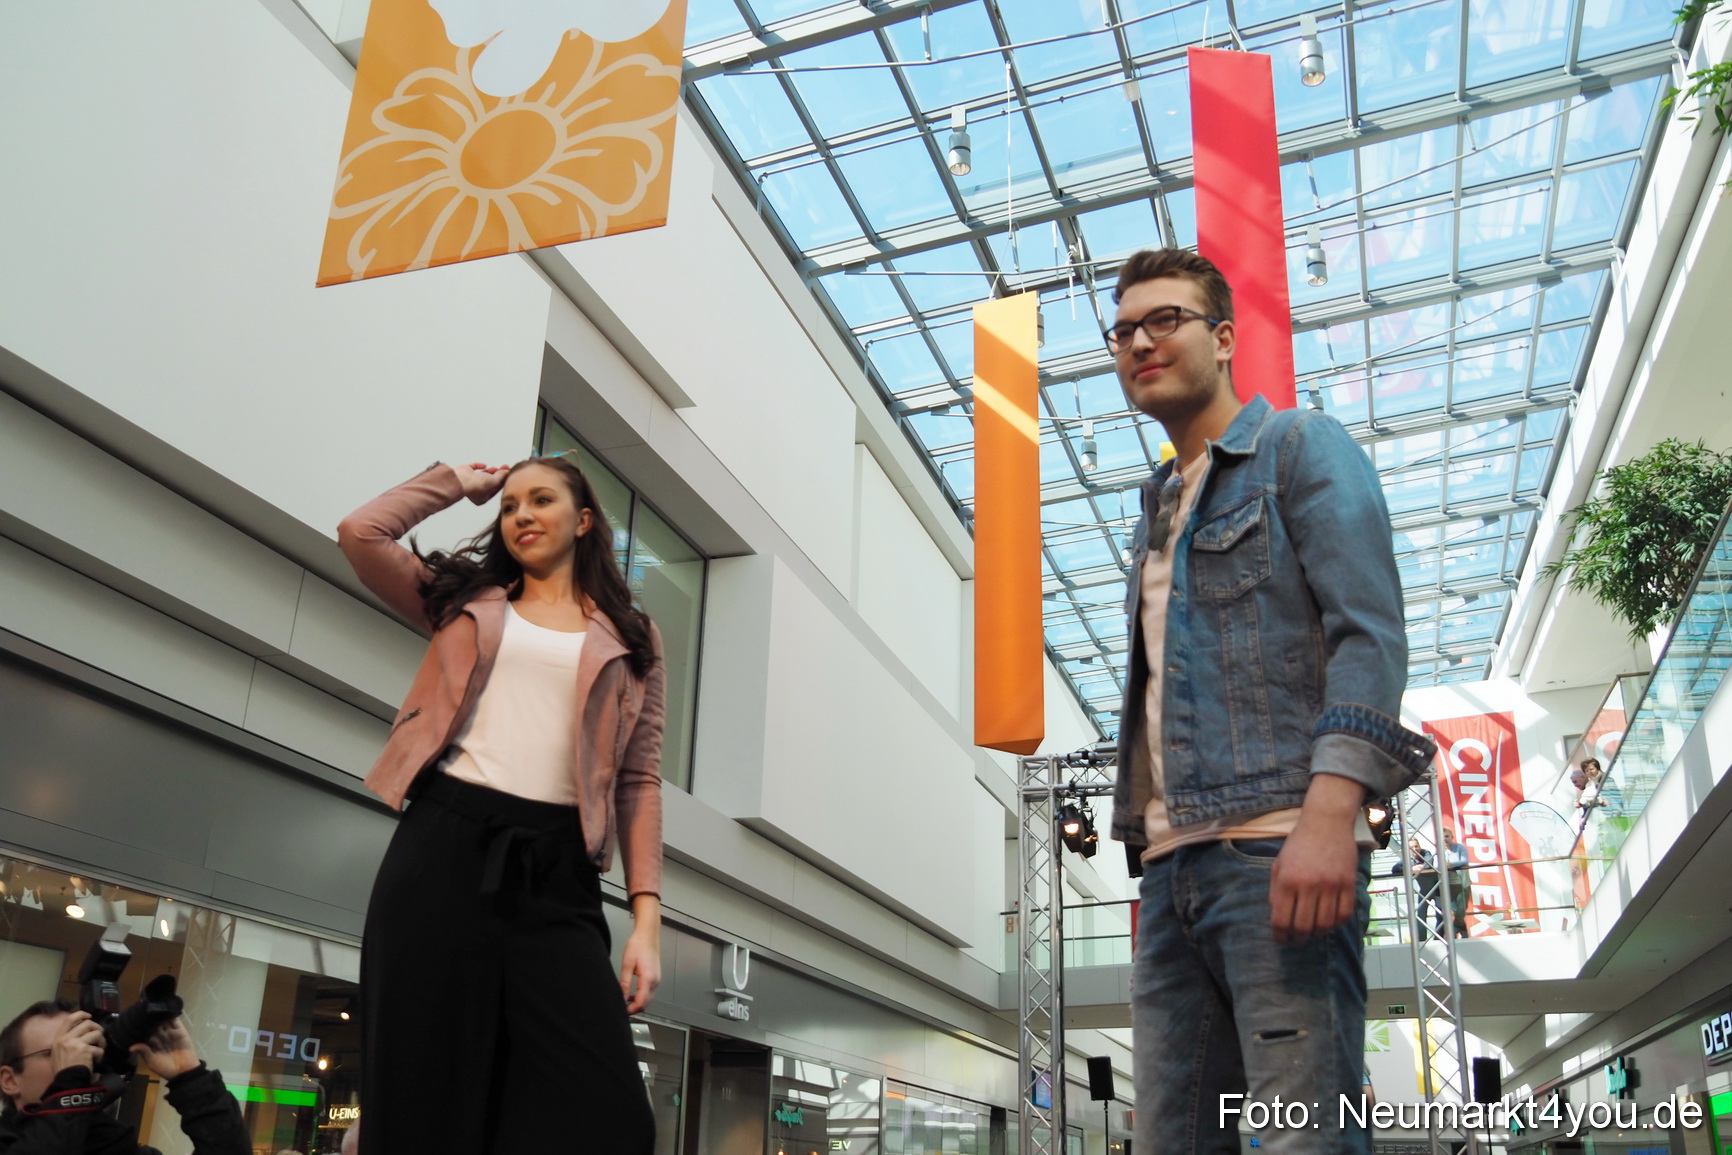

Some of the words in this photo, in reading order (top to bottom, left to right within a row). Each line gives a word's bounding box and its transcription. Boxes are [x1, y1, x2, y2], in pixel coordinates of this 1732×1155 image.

[1449, 737, 1504, 938] CINEPLEX
[725, 943, 750, 991] U
[724, 997, 750, 1021] eins
[1701, 1012, 1732, 1056] DEP
[60, 1093, 92, 1107] EOS
[329, 1106, 359, 1120] U-EINS
